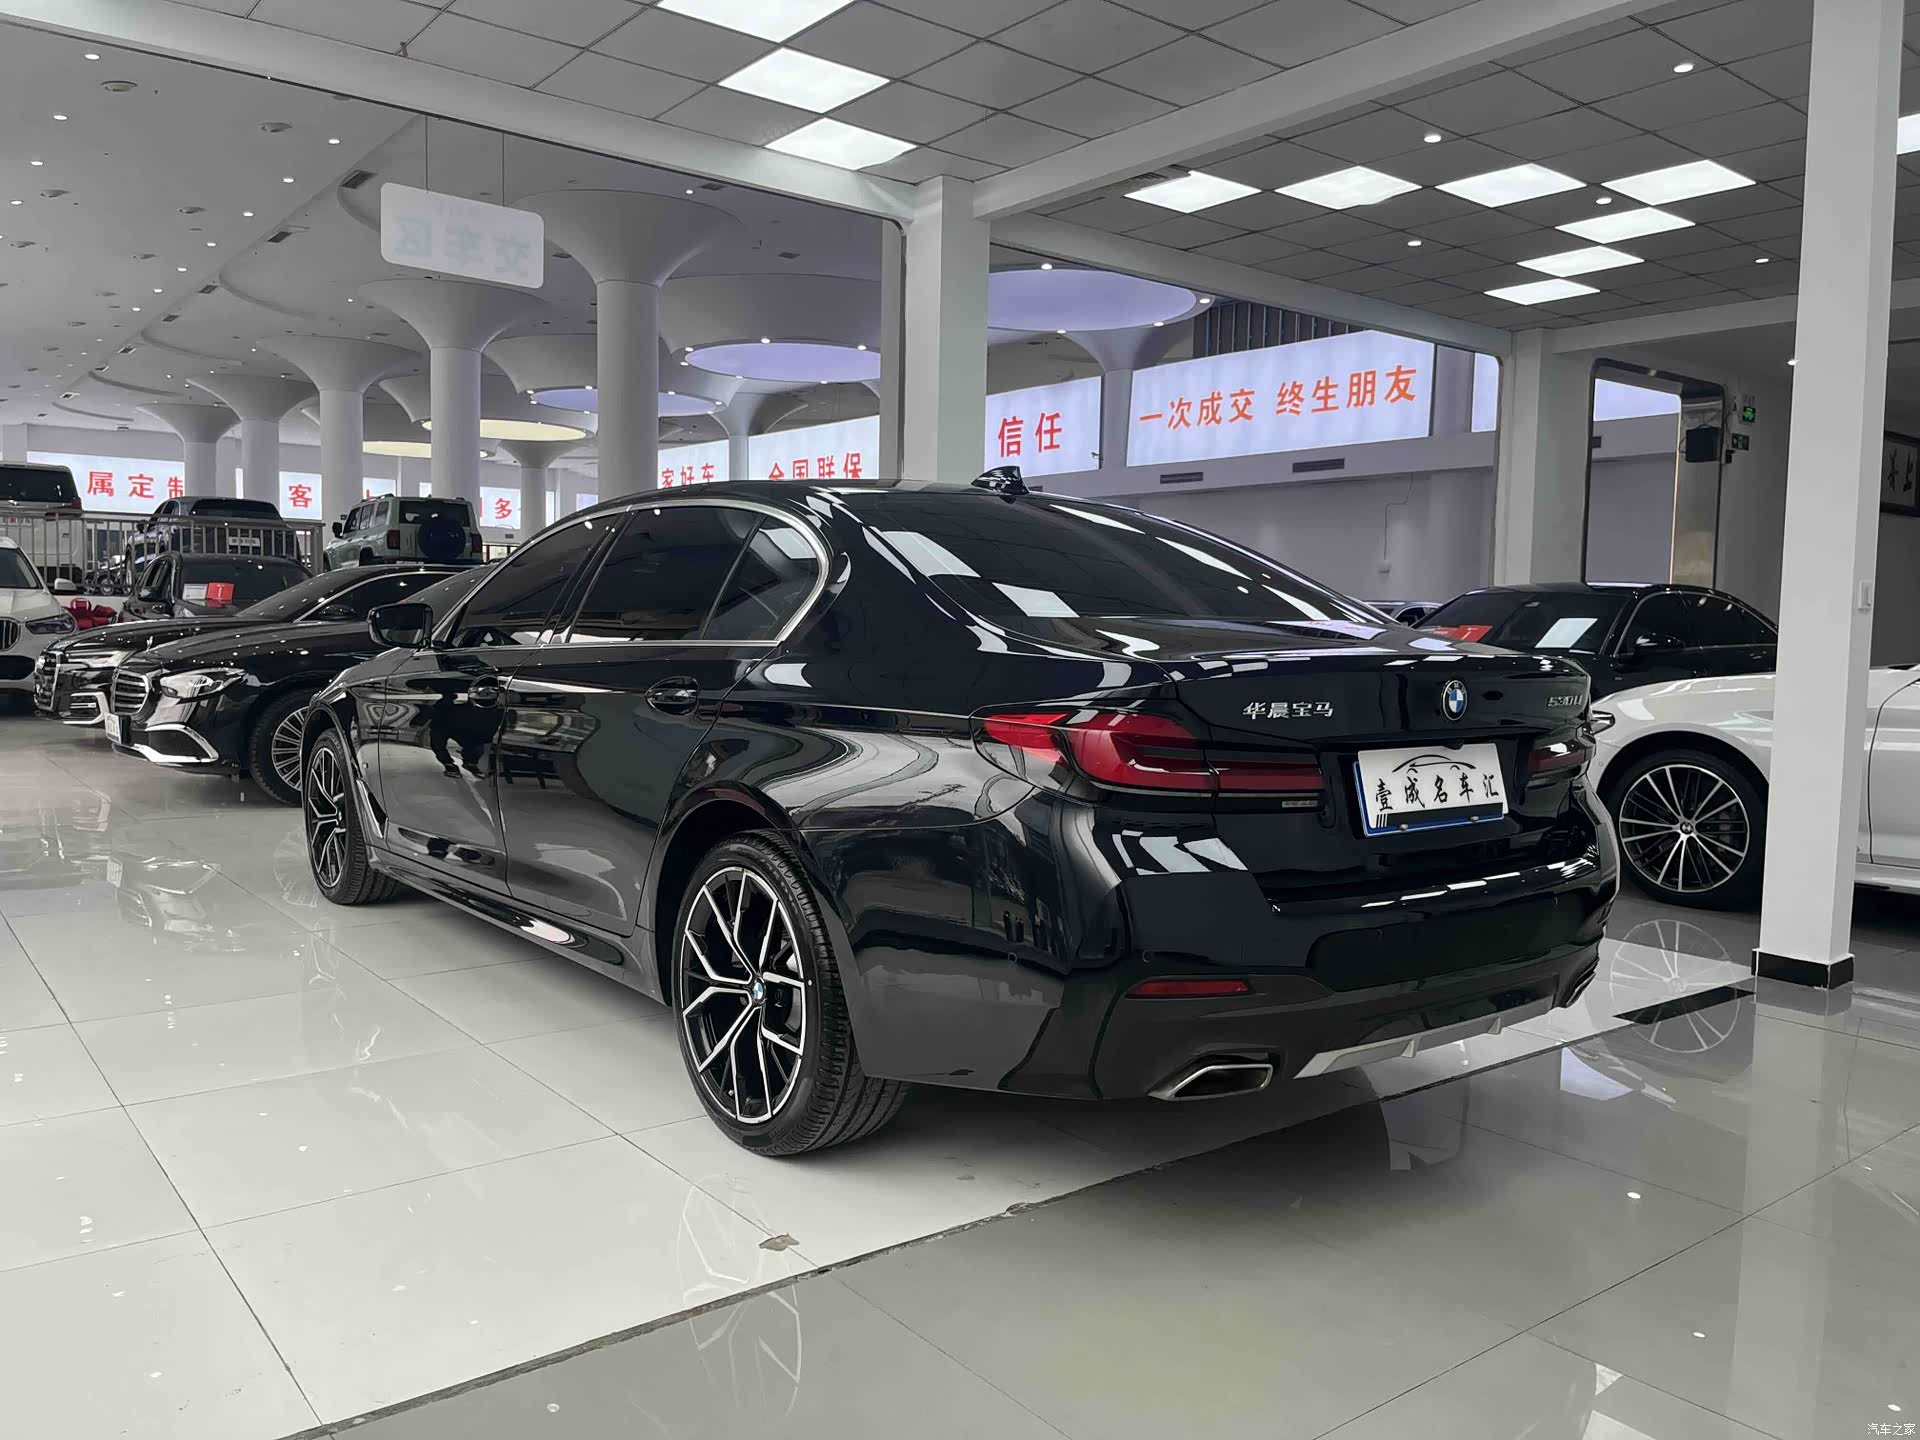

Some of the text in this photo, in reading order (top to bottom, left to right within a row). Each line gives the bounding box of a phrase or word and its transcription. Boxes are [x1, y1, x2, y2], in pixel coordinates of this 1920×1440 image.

[1139, 364, 1417, 430] 一次成交 终生朋友
[998, 412, 1062, 457] 信任
[288, 484, 312, 508] 客
[1243, 702, 1334, 720] 华晨宝马
[1376, 772, 1498, 812] 壹成名车汇
